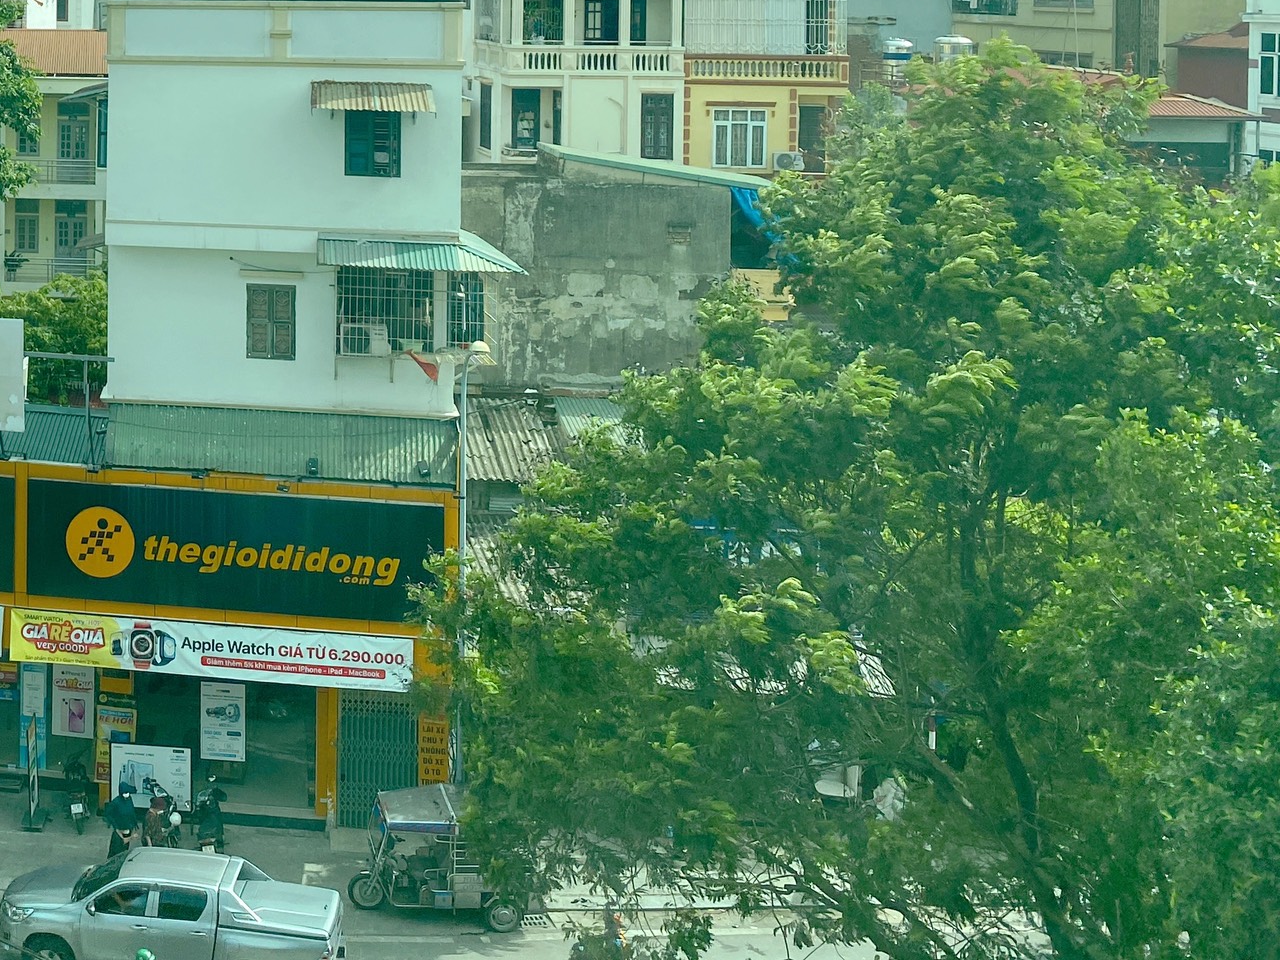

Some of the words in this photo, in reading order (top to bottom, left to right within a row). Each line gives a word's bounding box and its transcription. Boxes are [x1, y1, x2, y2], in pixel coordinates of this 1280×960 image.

[143, 535, 400, 586] thegioididong
[339, 575, 370, 585] .com
[22, 623, 48, 639] GIÁ
[50, 621, 72, 642] RẺ
[70, 628, 104, 645] QUÁ
[36, 641, 57, 652] very
[59, 642, 88, 653] GOOD!
[181, 637, 224, 653] Apple
[227, 640, 275, 656] Watch
[278, 643, 303, 658] GIÁ
[306, 644, 327, 660] TỪ
[328, 650, 405, 665] 6.290.000
[298, 666, 322, 674] iPhone
[348, 669, 380, 678] MacBook
